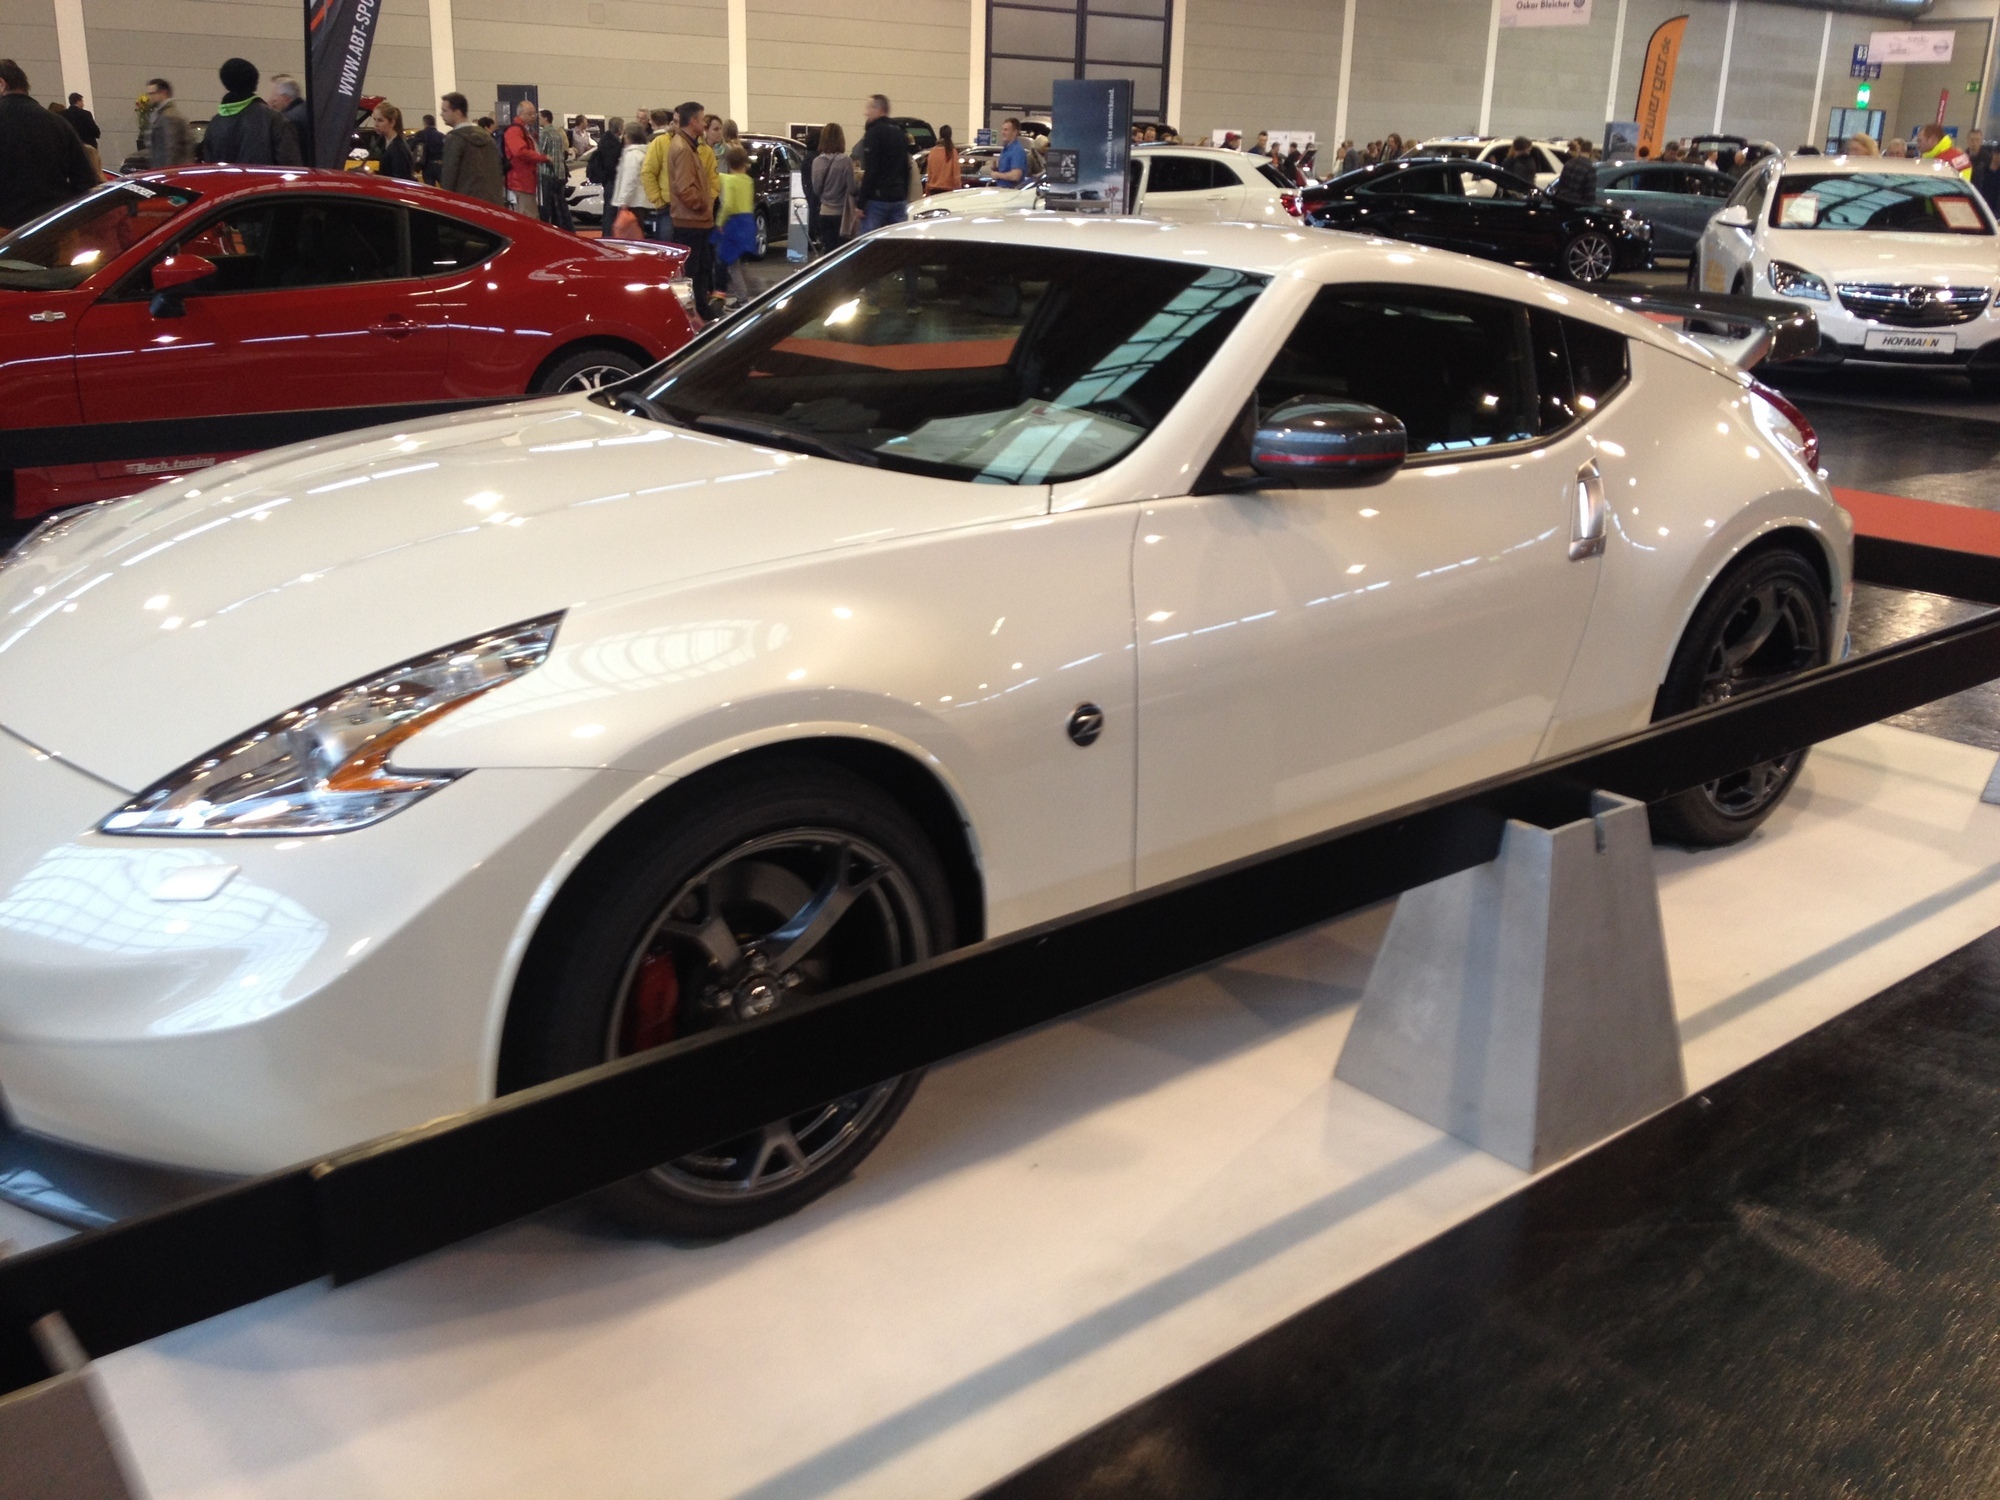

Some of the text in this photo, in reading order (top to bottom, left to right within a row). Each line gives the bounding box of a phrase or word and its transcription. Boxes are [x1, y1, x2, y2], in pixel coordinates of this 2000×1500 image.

[1516, 0, 1570, 10] Oskar Bleicher
[1643, 37, 1672, 143] zwerger.de
[1882, 336, 1939, 347] HOFMANN
